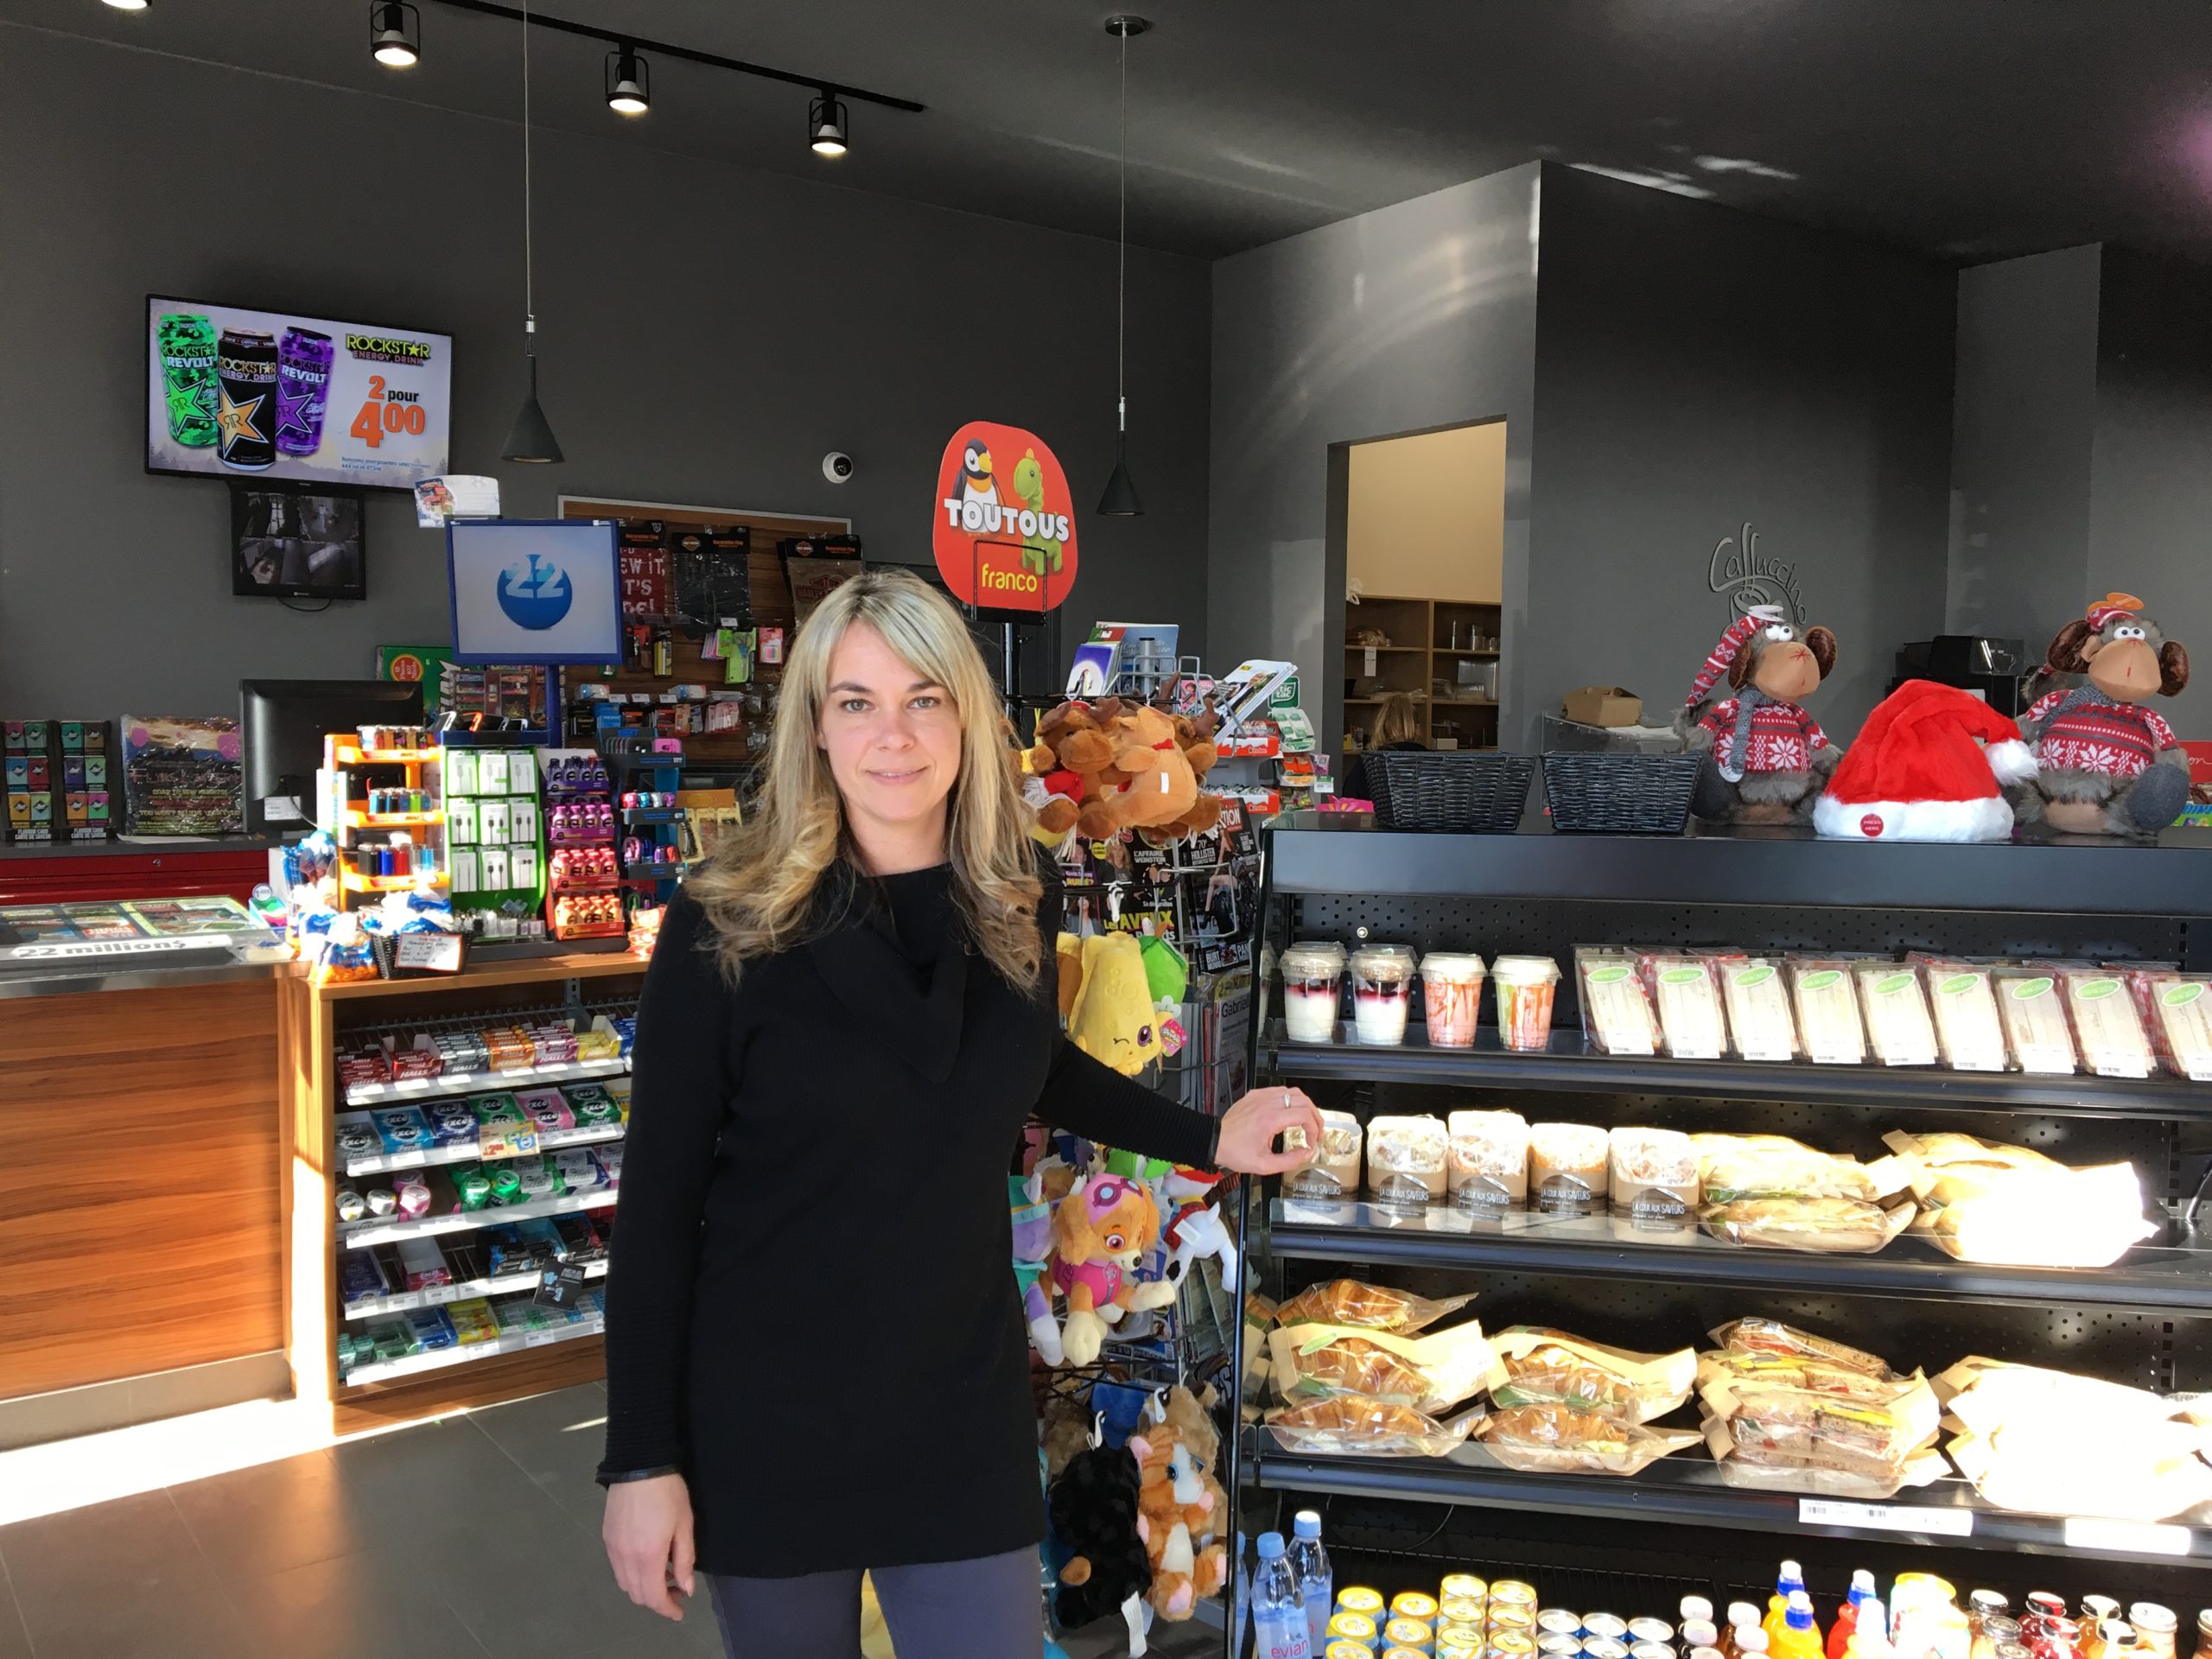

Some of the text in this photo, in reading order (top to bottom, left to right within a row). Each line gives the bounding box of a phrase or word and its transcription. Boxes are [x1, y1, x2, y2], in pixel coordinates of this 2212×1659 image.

[167, 356, 213, 368] REVOLT
[353, 350, 423, 365] ENERGY DRINK
[282, 365, 327, 384] REVOLT
[368, 375, 419, 402] 2 pour
[944, 498, 1069, 542] TOUTOUS
[982, 563, 1037, 593] franco
[18, 947, 58, 957] 22
[400, 1069, 429, 1078] HALLS
[452, 1065, 478, 1073] HALLS
[1293, 1182, 1341, 1196] LA COUR AUX SAVEURS
[1379, 1187, 1429, 1201] LA COUR AUX SAVEURS
[1459, 1188, 1510, 1204] LA COUR AUX SAVEURS
[1541, 1188, 1591, 1201] LA COUR AUX SAVEURS
[1632, 1202, 1685, 1215] LA COUR AUX SAVEURS
[1271, 1639, 1308, 1659] evian
